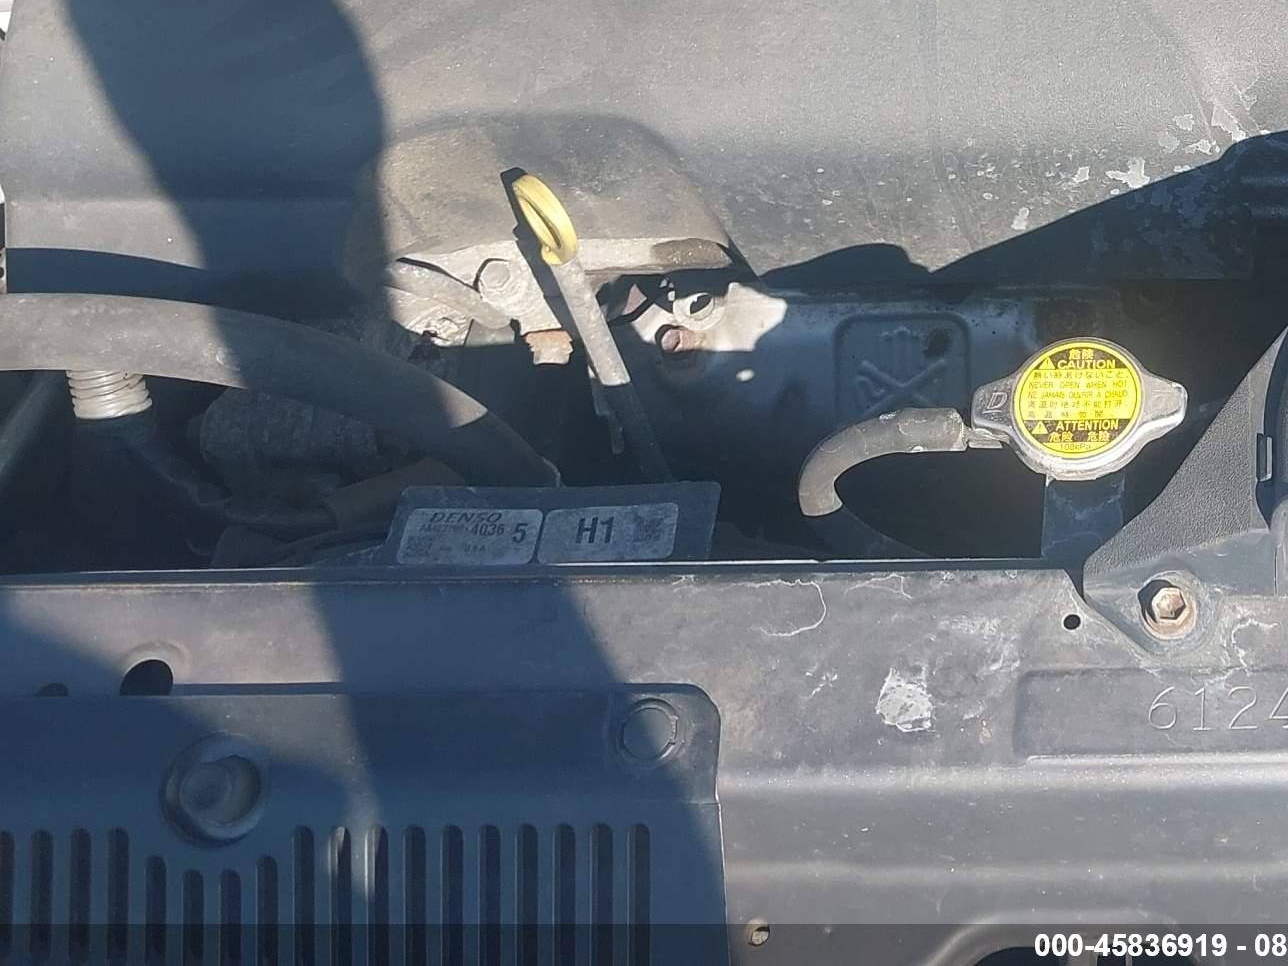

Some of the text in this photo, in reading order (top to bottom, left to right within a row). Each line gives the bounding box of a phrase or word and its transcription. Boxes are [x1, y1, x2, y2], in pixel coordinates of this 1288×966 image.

[1057, 359, 1116, 369] CAUTION
[1028, 381, 1054, 389] NEVER
[1060, 381, 1080, 389] OPEN
[1086, 380, 1107, 389] WHEN
[1028, 390, 1038, 399] NE
[1055, 419, 1119, 431] ATTENTION
[430, 512, 502, 523] DENSO
[511, 522, 529, 544] 5
[575, 516, 615, 544] H1
